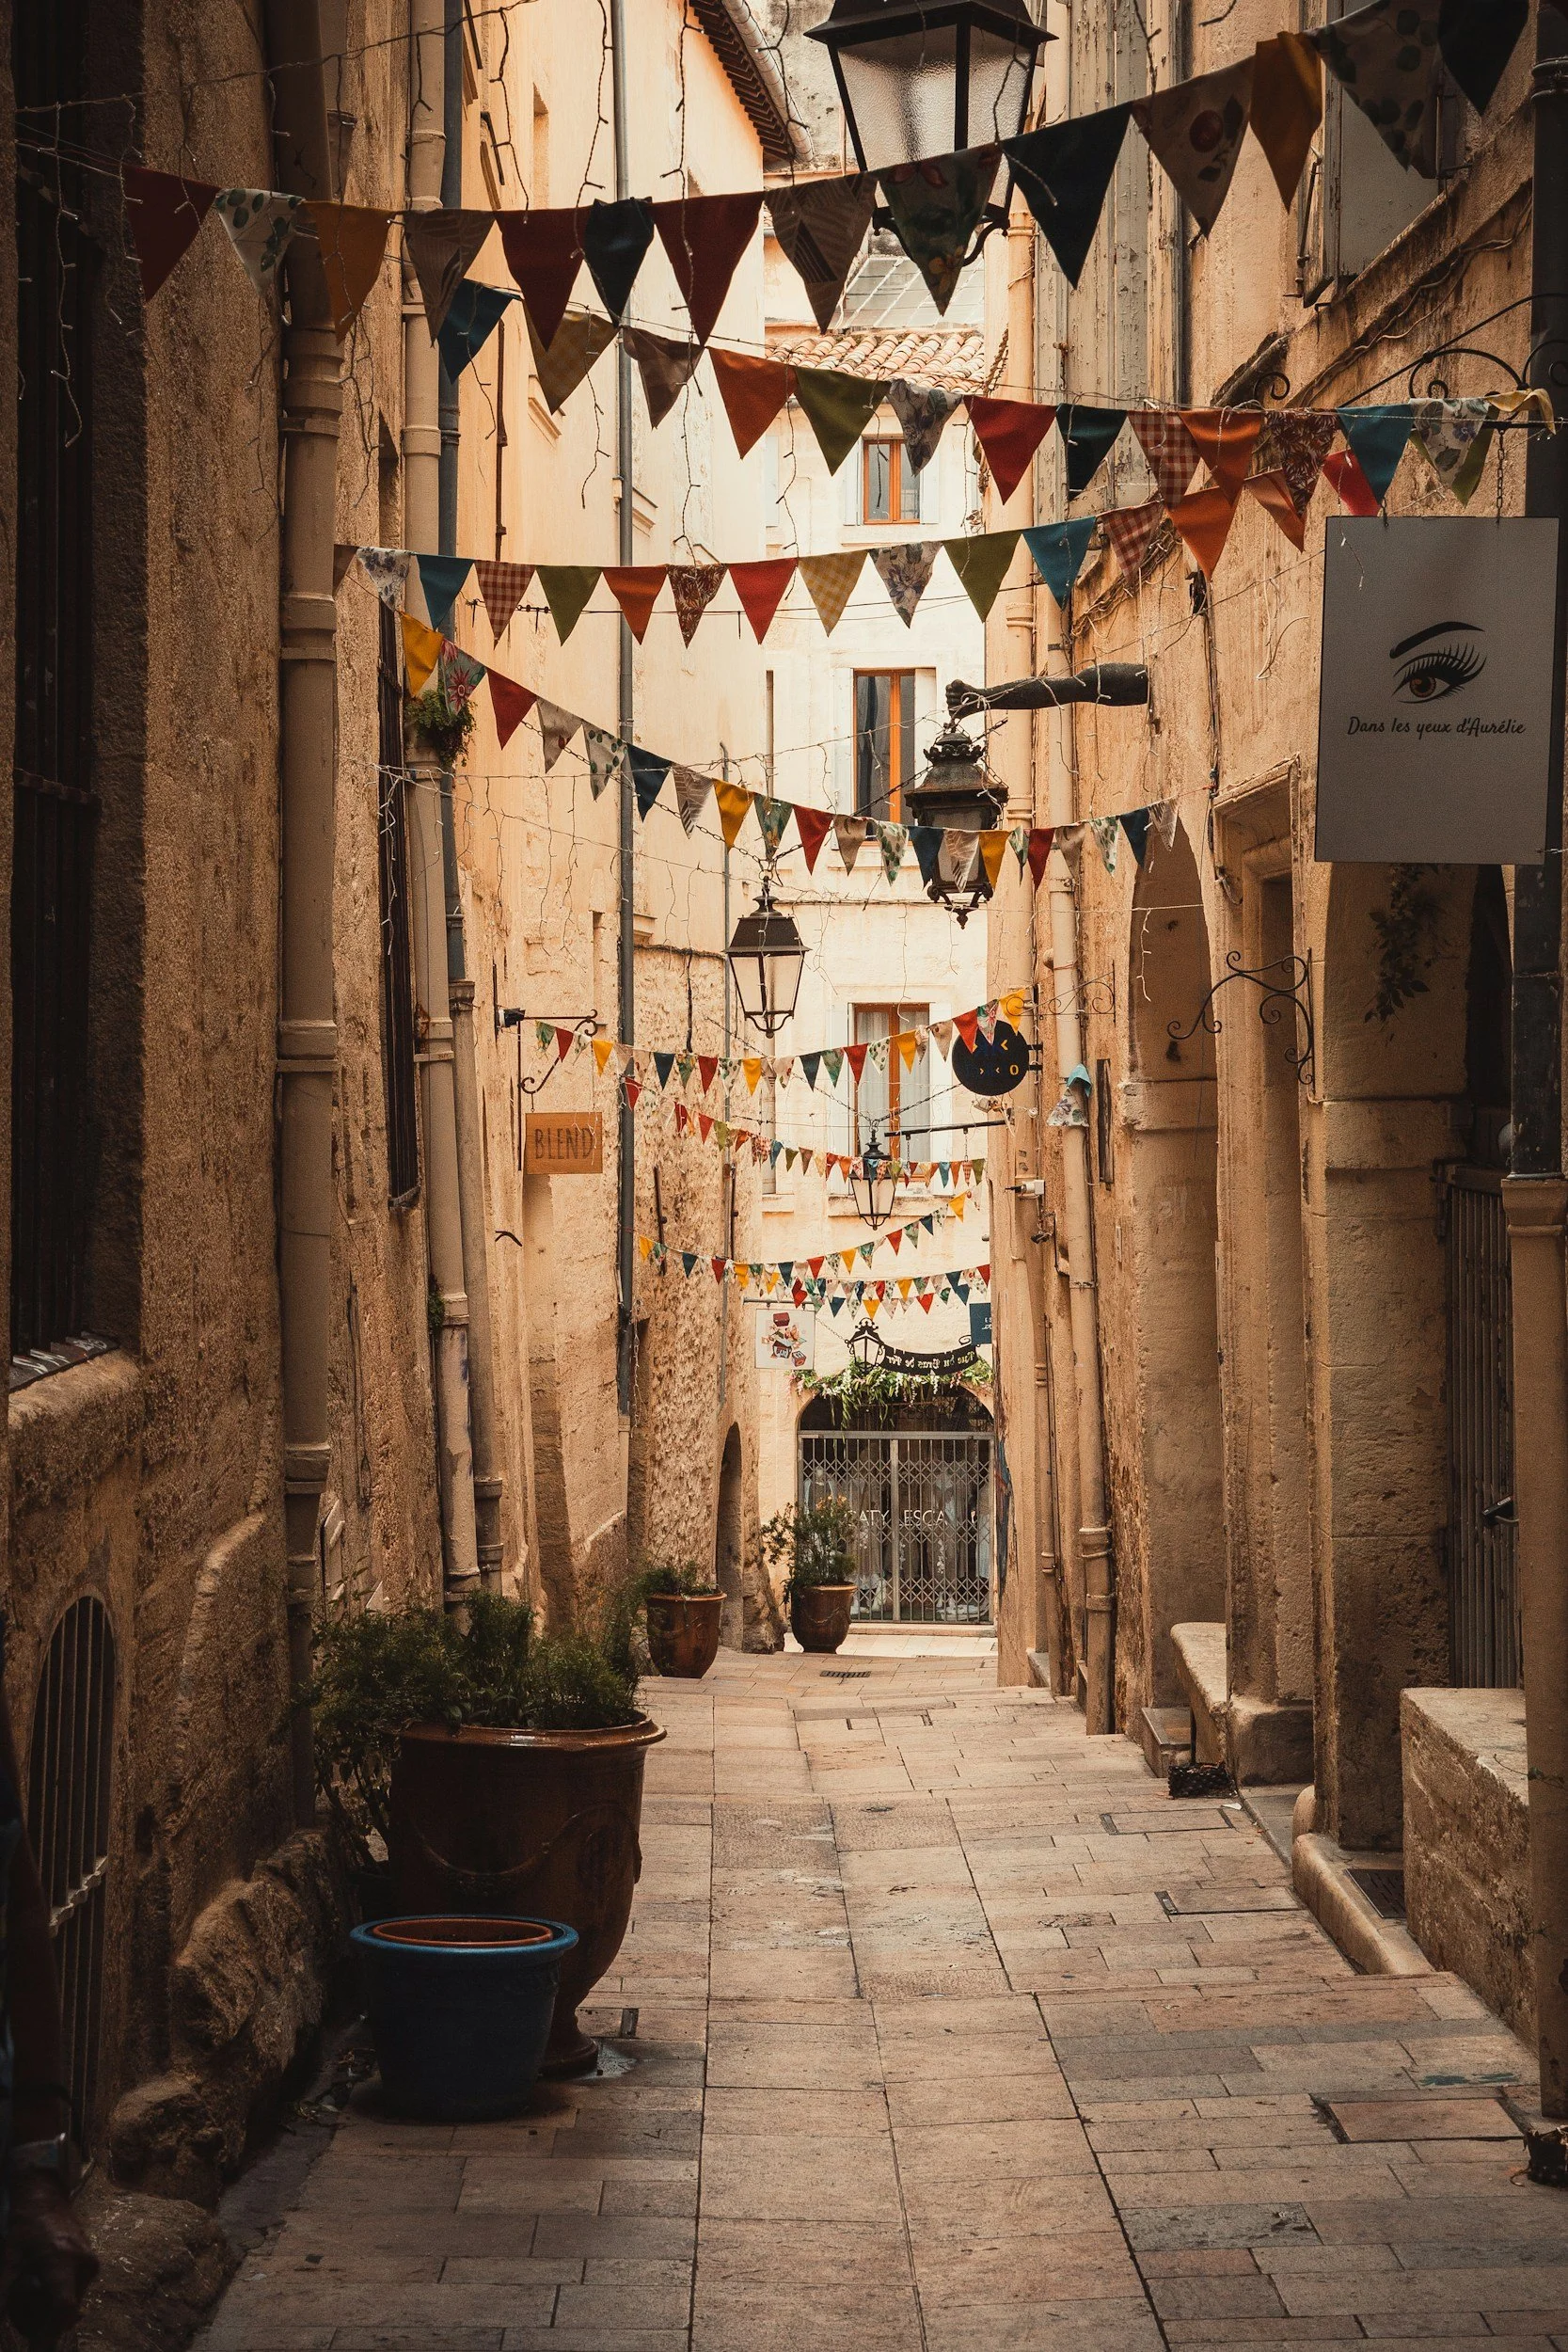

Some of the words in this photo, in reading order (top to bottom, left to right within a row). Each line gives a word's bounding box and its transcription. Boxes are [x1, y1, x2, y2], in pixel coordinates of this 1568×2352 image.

[1347, 716, 1385, 735] Dans
[1391, 718, 1410, 733] les
[1417, 723, 1451, 740] yeux
[1456, 717, 1526, 737] d'Aurélie
[534, 1127, 594, 1159] BLEND
[899, 1509, 948, 1527] ESCA
